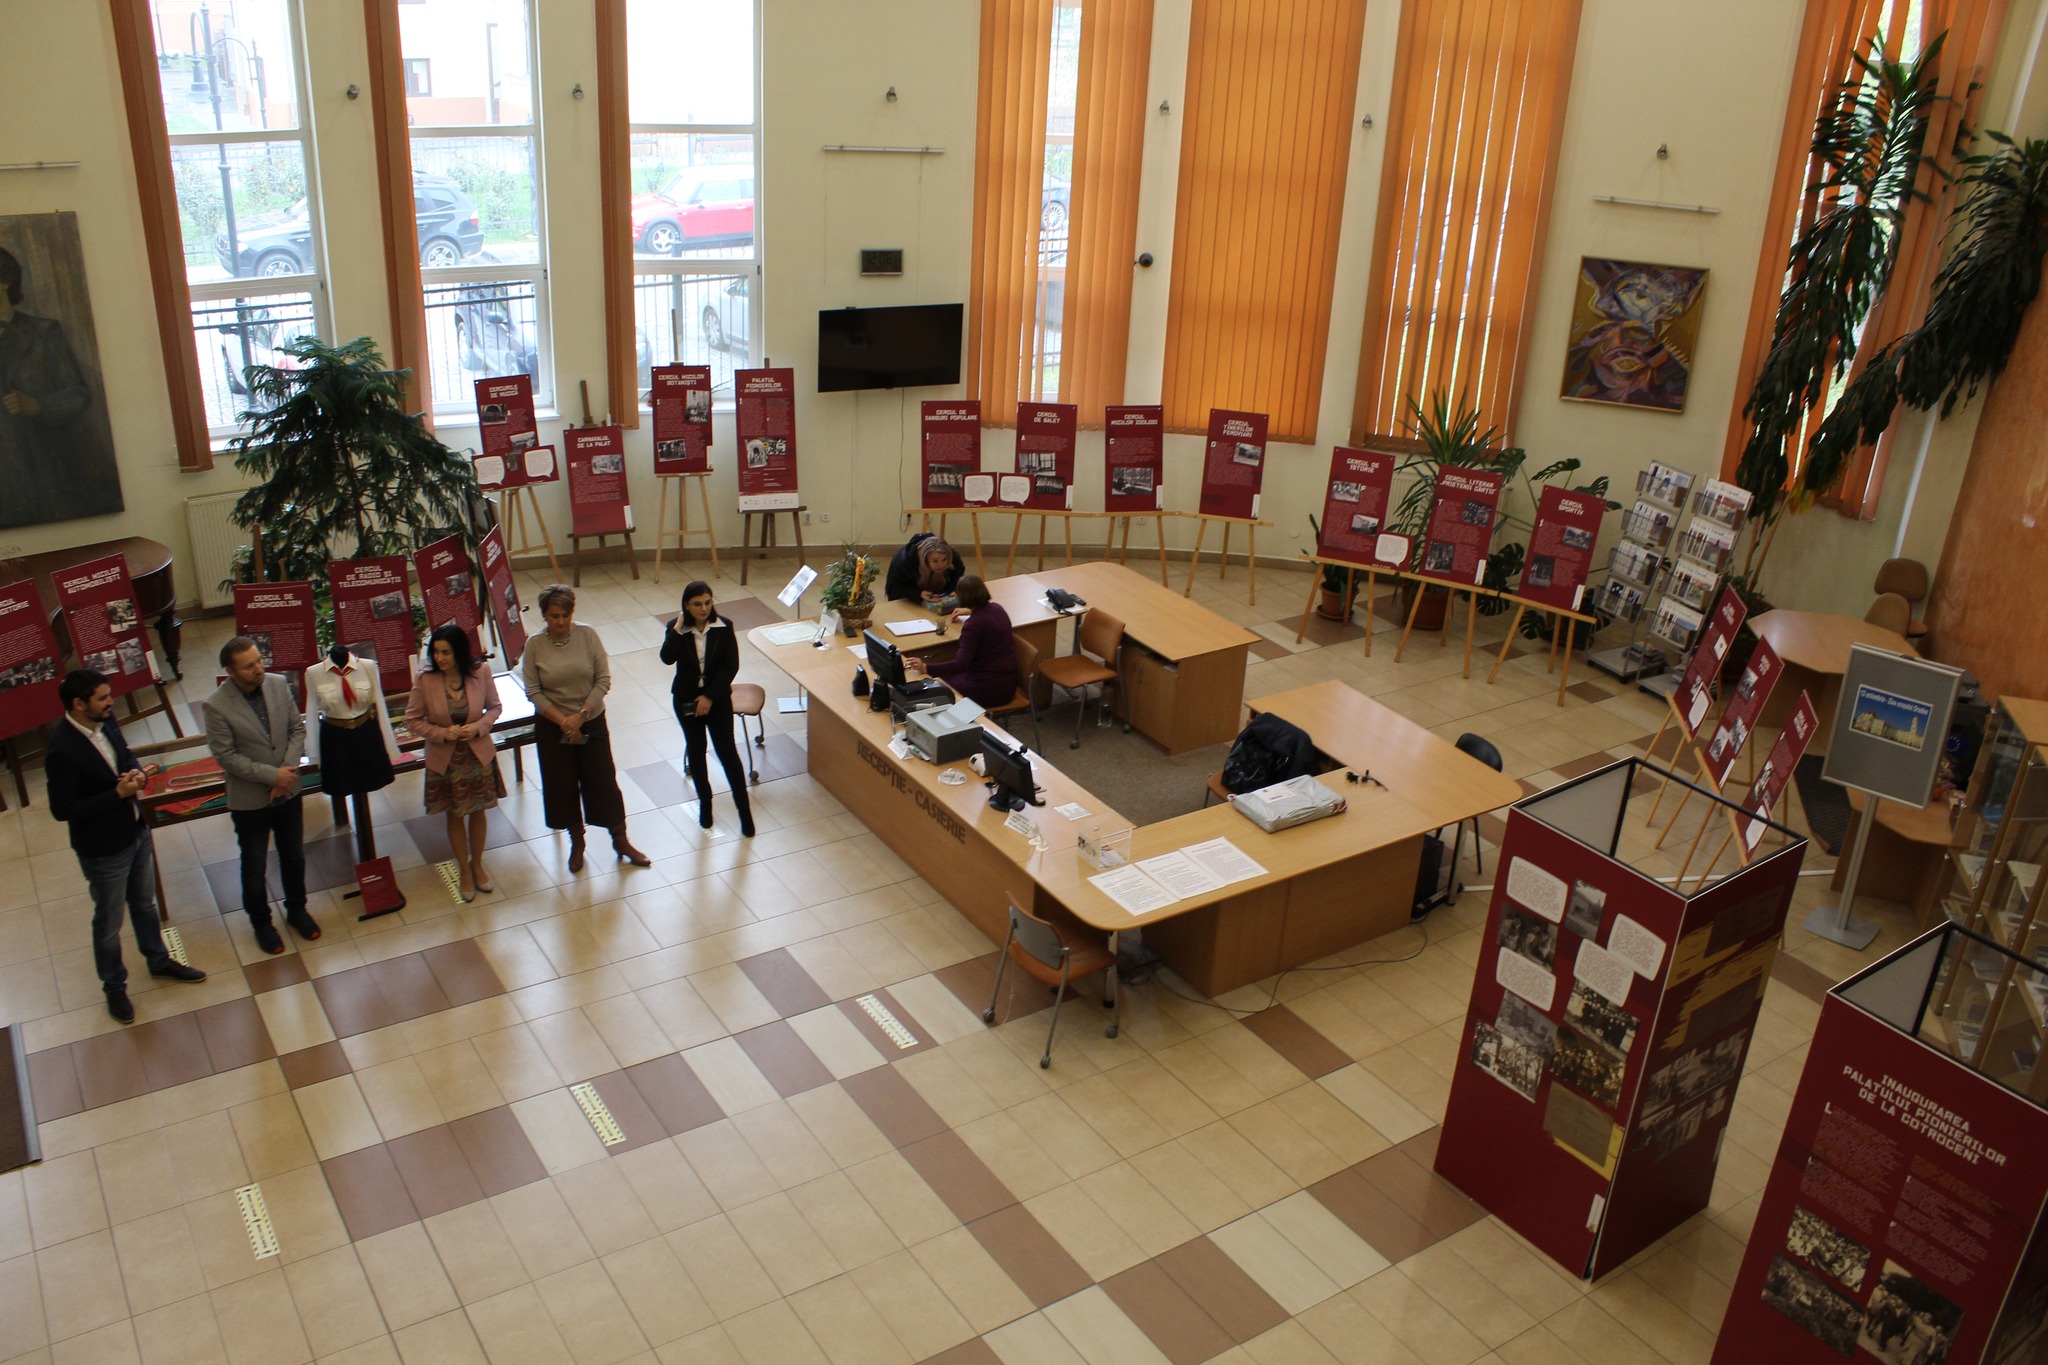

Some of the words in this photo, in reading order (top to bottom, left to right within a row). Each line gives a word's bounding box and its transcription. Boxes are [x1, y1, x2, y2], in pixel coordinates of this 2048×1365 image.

[1227, 419, 1249, 427] CERCUL
[1346, 457, 1370, 467] CERCUL
[1371, 461, 1380, 469] DE
[1445, 474, 1468, 484] CERCUL
[1468, 478, 1495, 489] LITERAR
[1560, 498, 1583, 509] CERCUL
[1558, 504, 1585, 516] SPORTIV
[354, 565, 382, 574] CERCUL
[346, 572, 357, 581] DE
[359, 571, 381, 580] RADIO
[63, 576, 90, 589] CERCUL
[254, 594, 281, 602] CERCUL
[283, 593, 294, 601] DE
[915, 790, 966, 844] CASIERIE
[1882, 1073, 1970, 1132] INAUGURAREA
[1843, 1065, 1910, 1112] PALATULUI
[1915, 1105, 2007, 1167] PIONIERILOR
[1858, 1087, 1876, 1105] DE
[1880, 1100, 1896, 1117] LA
[1900, 1112, 1979, 1166] COTROCENI
